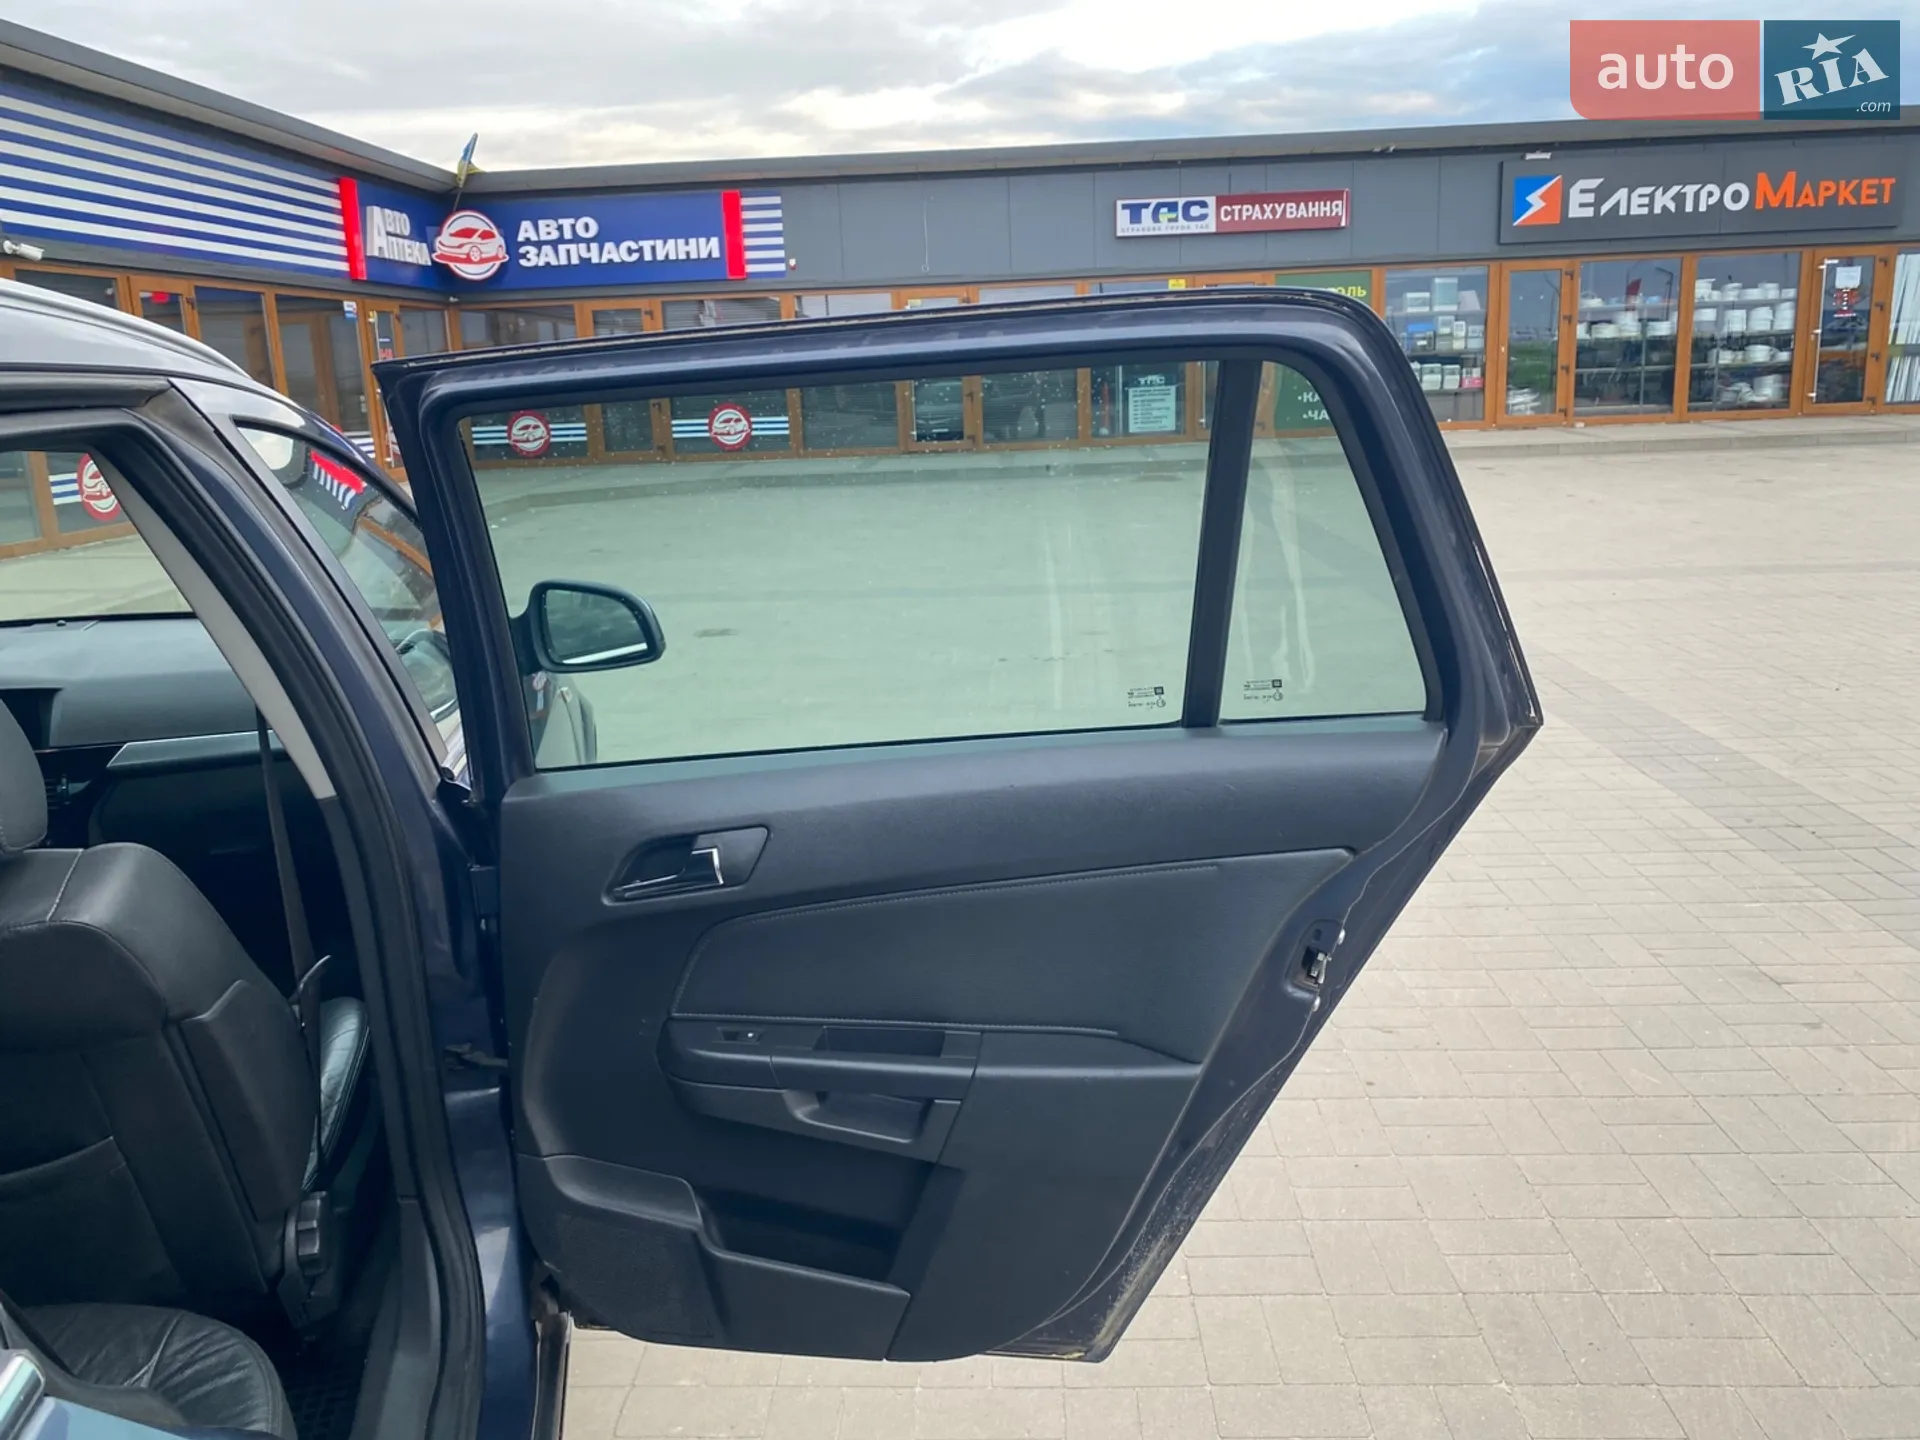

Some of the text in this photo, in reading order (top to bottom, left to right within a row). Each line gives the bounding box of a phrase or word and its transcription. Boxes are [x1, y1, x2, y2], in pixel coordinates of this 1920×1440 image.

[1220, 200, 1343, 222] СТРАХУВАННЯ
[517, 215, 599, 243] АВТО
[518, 237, 720, 268] ЗАПЧАСТИНИ
